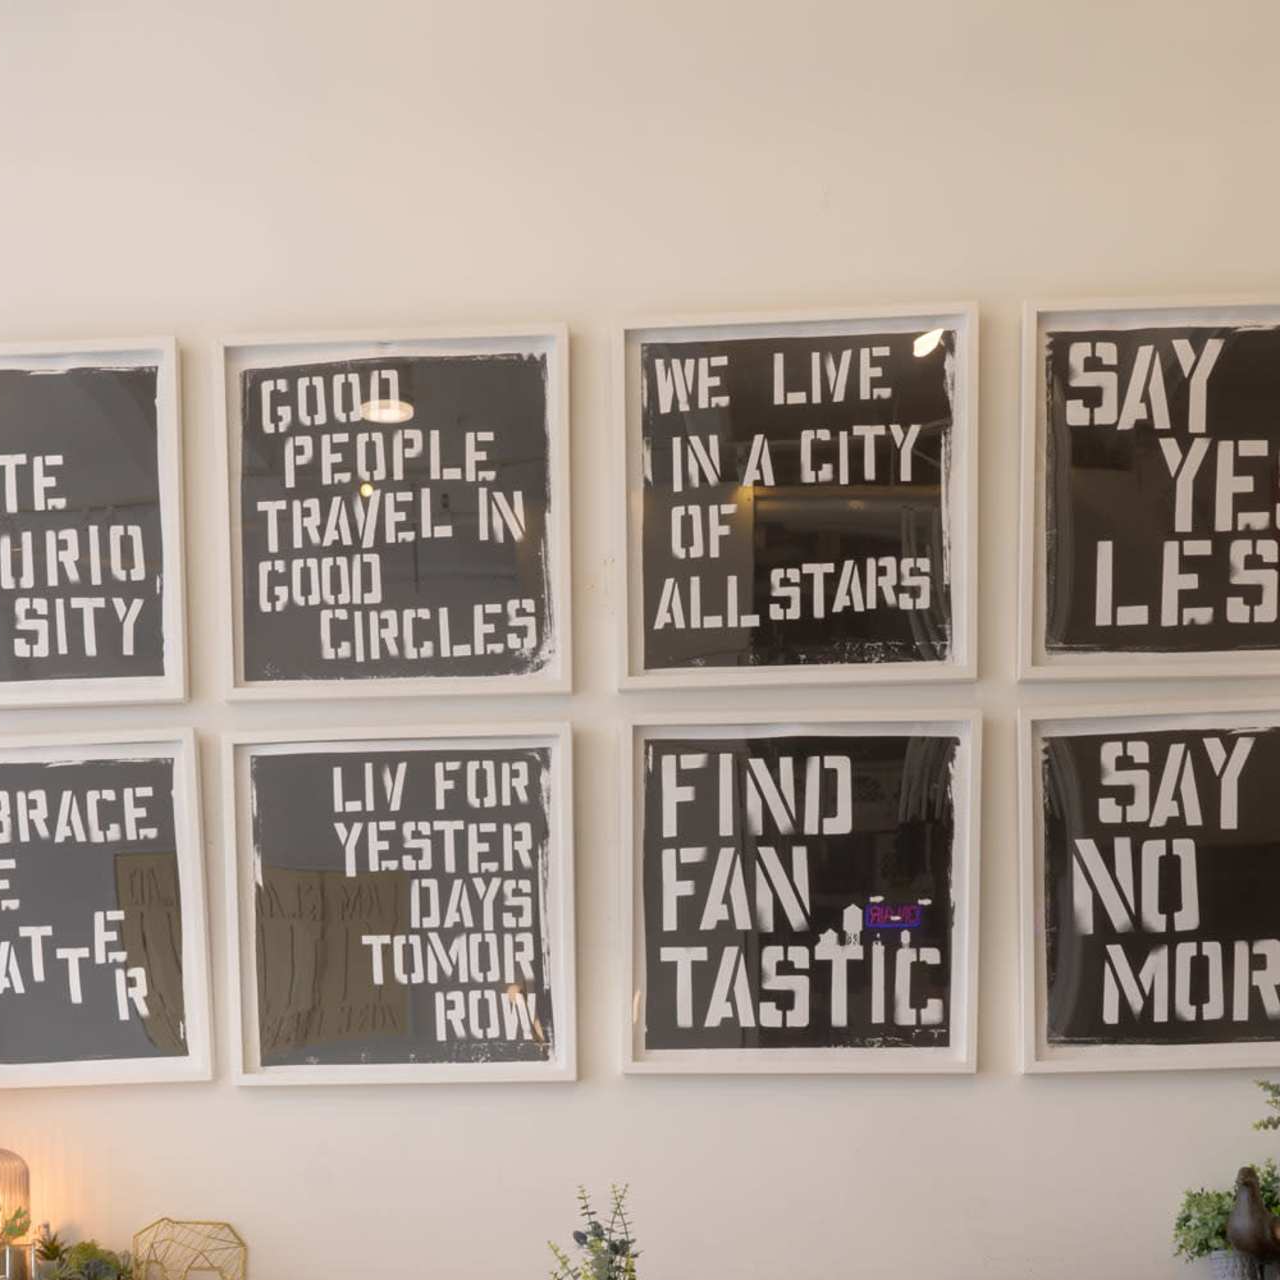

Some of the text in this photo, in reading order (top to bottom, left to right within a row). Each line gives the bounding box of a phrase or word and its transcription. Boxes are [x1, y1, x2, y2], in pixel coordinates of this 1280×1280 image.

[261, 370, 400, 433] GOOD
[654, 346, 891, 413] WE LIVE
[1066, 338, 1224, 434] SAY
[285, 429, 497, 489] PEOPLE
[672, 424, 922, 493] IN A CITY
[257, 486, 526, 553] TRAVEL IN
[671, 504, 738, 560] OF
[259, 553, 382, 613] GOOD
[653, 556, 930, 630] ALL STARS
[14, 596, 144, 659] SITY
[321, 598, 537, 662] CIRCLES
[332, 760, 528, 813] LIV FOR
[661, 753, 852, 838] FIND
[1098, 737, 1255, 829] SAY
[334, 821, 532, 878] YESTER
[410, 877, 532, 929] DAYS
[661, 845, 810, 933] FAN
[1074, 838, 1200, 934] NO
[362, 932, 535, 986] TOMOR
[660, 945, 944, 1028] TASTIC
[436, 989, 536, 1042] ROW
